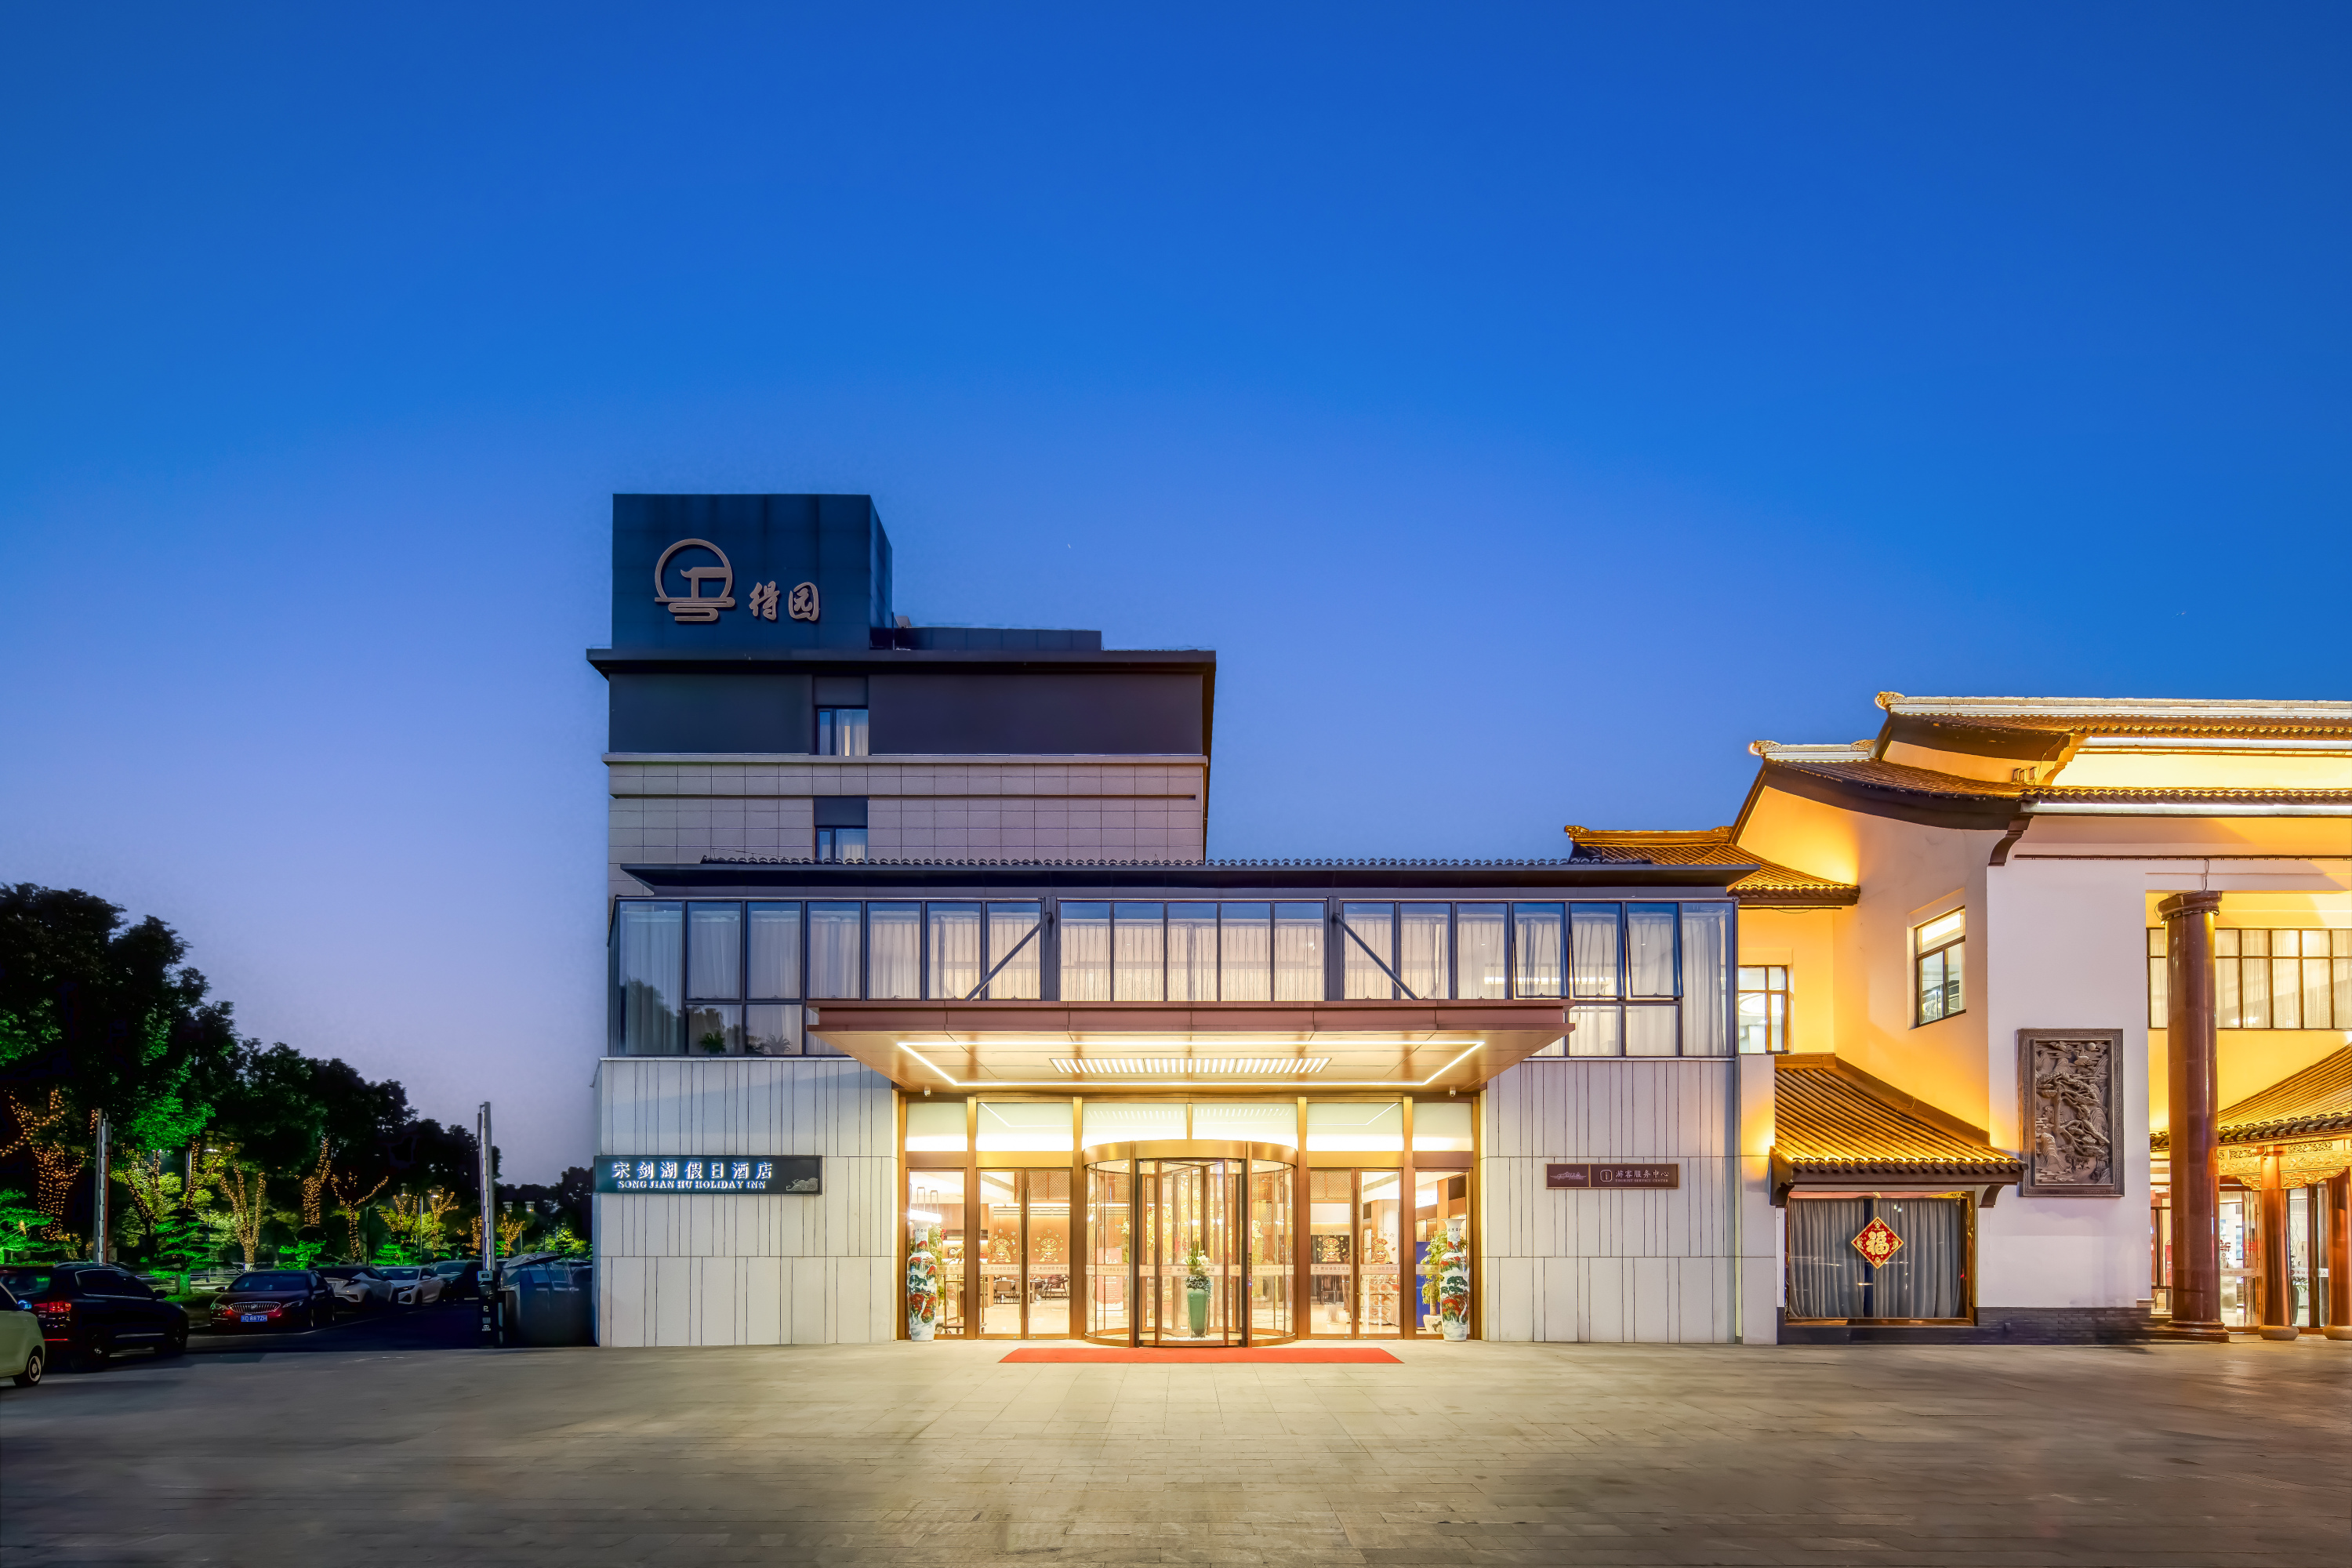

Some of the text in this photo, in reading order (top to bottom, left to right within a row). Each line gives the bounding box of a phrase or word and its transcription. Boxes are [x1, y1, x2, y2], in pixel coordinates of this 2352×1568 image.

[612, 1161, 772, 1179] 宋剑湖假日酒店
[1615, 1170, 1669, 1178] 游客服务中心
[617, 1180, 766, 1189] SONG JIAN HU HOLIDAY INN
[1865, 1230, 1890, 1256] 福
